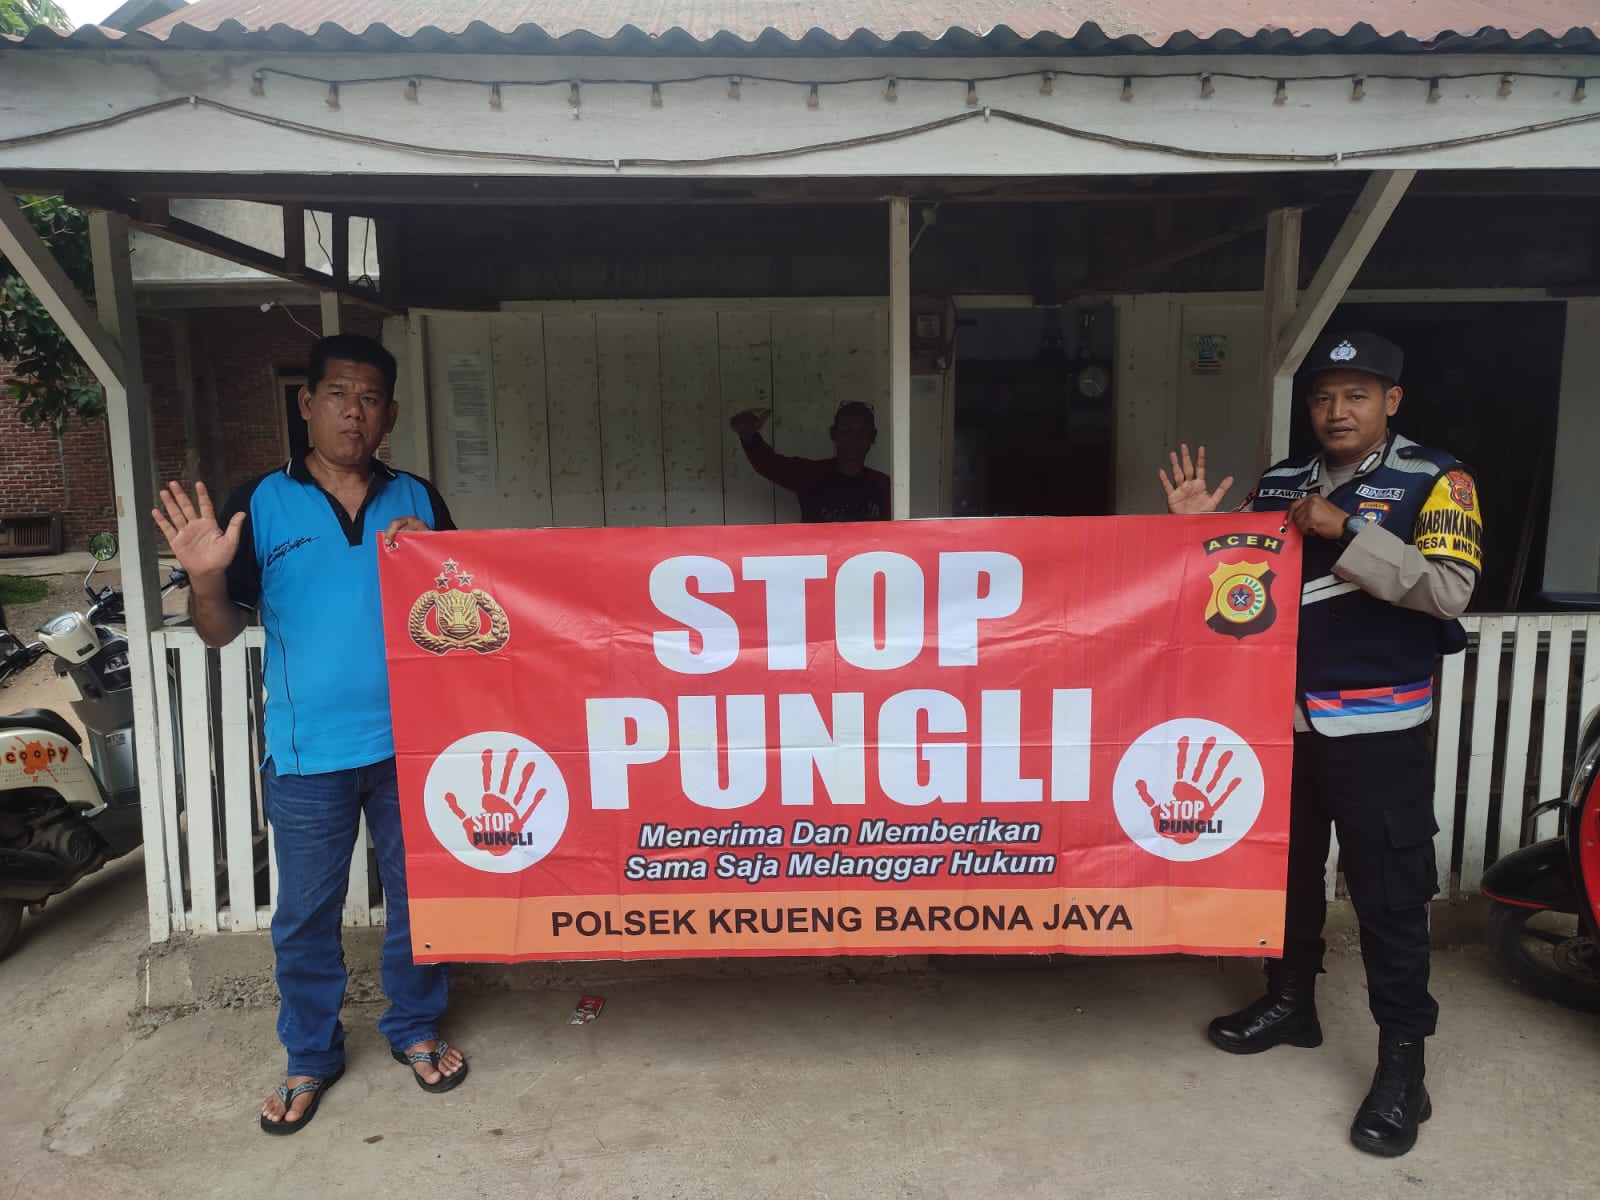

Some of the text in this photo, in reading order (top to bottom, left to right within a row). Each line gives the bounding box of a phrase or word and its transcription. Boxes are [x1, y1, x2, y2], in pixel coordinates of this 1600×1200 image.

[1360, 486, 1401, 499] BINMAS
[1208, 535, 1279, 551] ACEH
[648, 551, 1024, 674] STOP
[0, 745, 69, 765] coopy
[585, 688, 1093, 809] PUNGLI
[1160, 799, 1205, 820] STOP
[472, 812, 515, 832] STOP
[1158, 819, 1223, 834] PUNGLI
[472, 831, 534, 846] PUNGLI
[638, 818, 1042, 848] Menerima Dan Memberikan
[625, 850, 1056, 884] Sama Saja Melanggar Hukum
[551, 903, 1134, 937] POLSEK KRUENG BARONA JAYA
